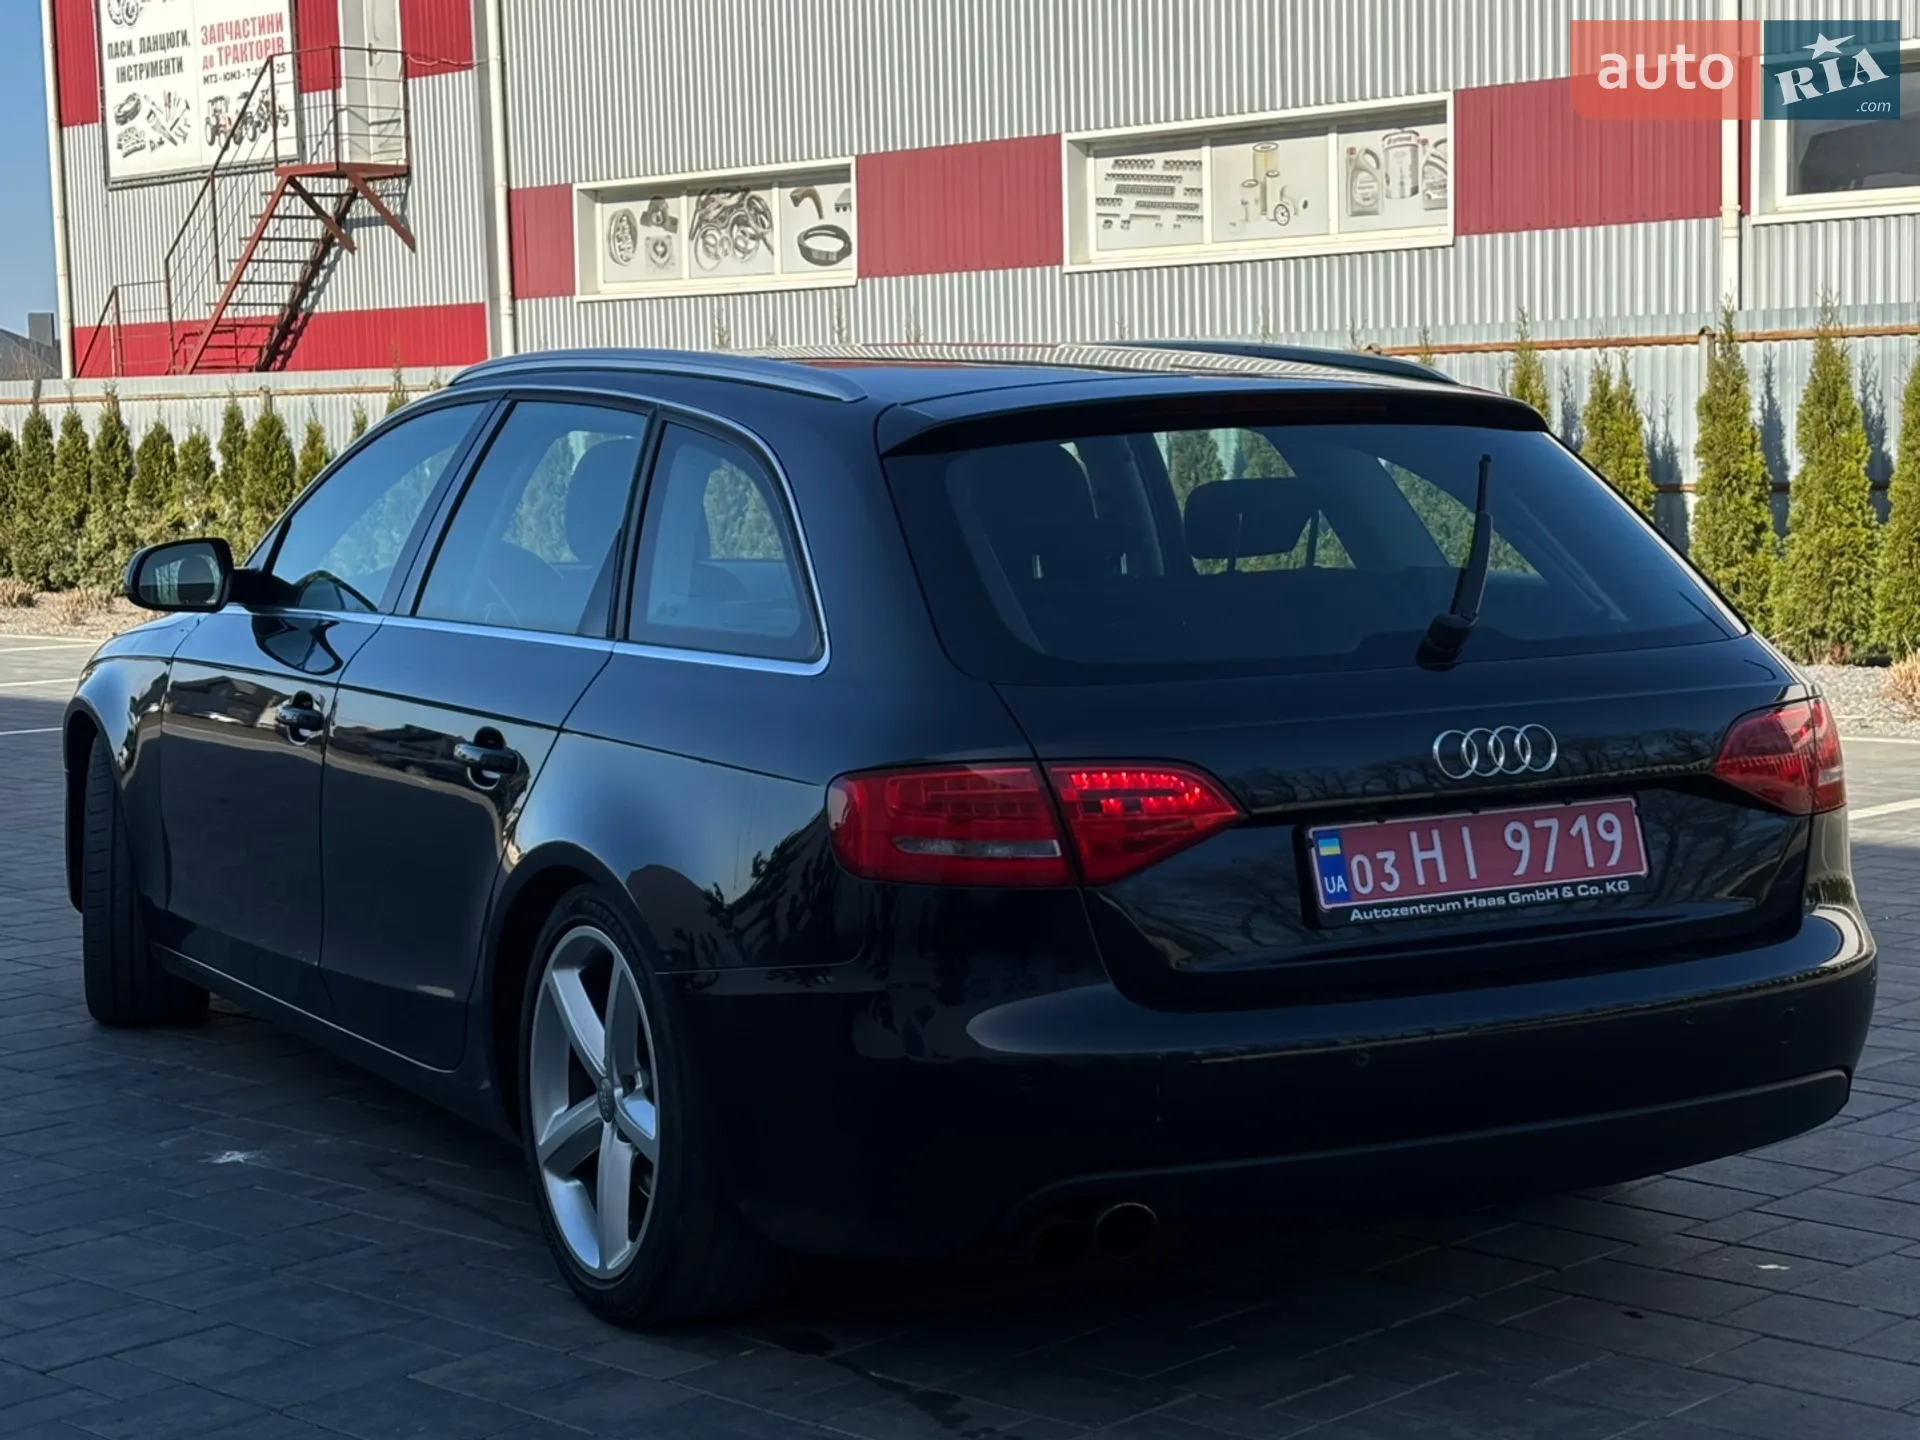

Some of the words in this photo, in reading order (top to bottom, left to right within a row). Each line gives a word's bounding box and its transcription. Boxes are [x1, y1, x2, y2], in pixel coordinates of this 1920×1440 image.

[107, 39, 136, 60] ПАСИ,
[139, 29, 191, 54] ЛАНЦЮГИ,
[200, 12, 284, 46] ЗАПЧАСТИНИ
[217, 36, 284, 66] ТРАКТОРІВ
[116, 56, 184, 84] ІНСТРУМЕНТИ
[1350, 850, 1401, 894] 03
[1410, 826, 1478, 885] HI
[1504, 812, 1624, 877] 9719
[1324, 875, 1348, 894] UA
[1350, 899, 1462, 922] Autozentrum
[1464, 894, 1506, 910] Haas
[1508, 886, 1559, 904] GmbH
[1562, 885, 1575, 898] &
[1577, 881, 1604, 896] Co.
[1605, 879, 1631, 892] KG
